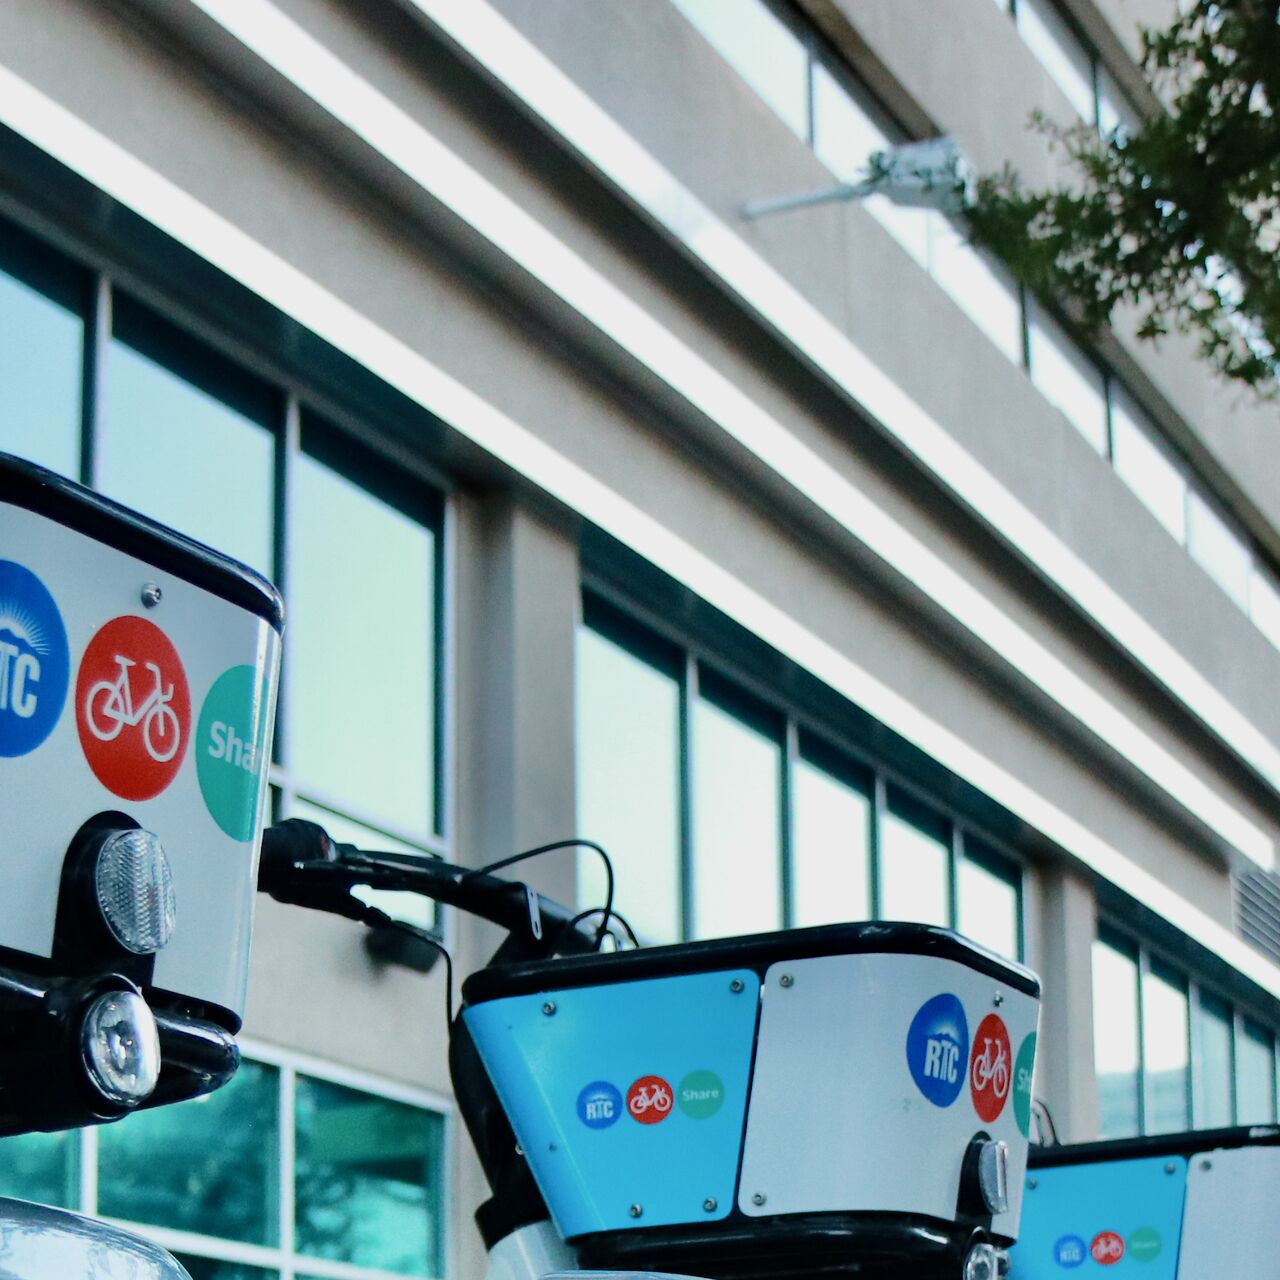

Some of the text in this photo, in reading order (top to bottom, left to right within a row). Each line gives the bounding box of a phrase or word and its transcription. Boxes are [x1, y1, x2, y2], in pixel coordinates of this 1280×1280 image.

[923, 1038, 960, 1085] RTC
[586, 1088, 720, 1120] RTC Share
